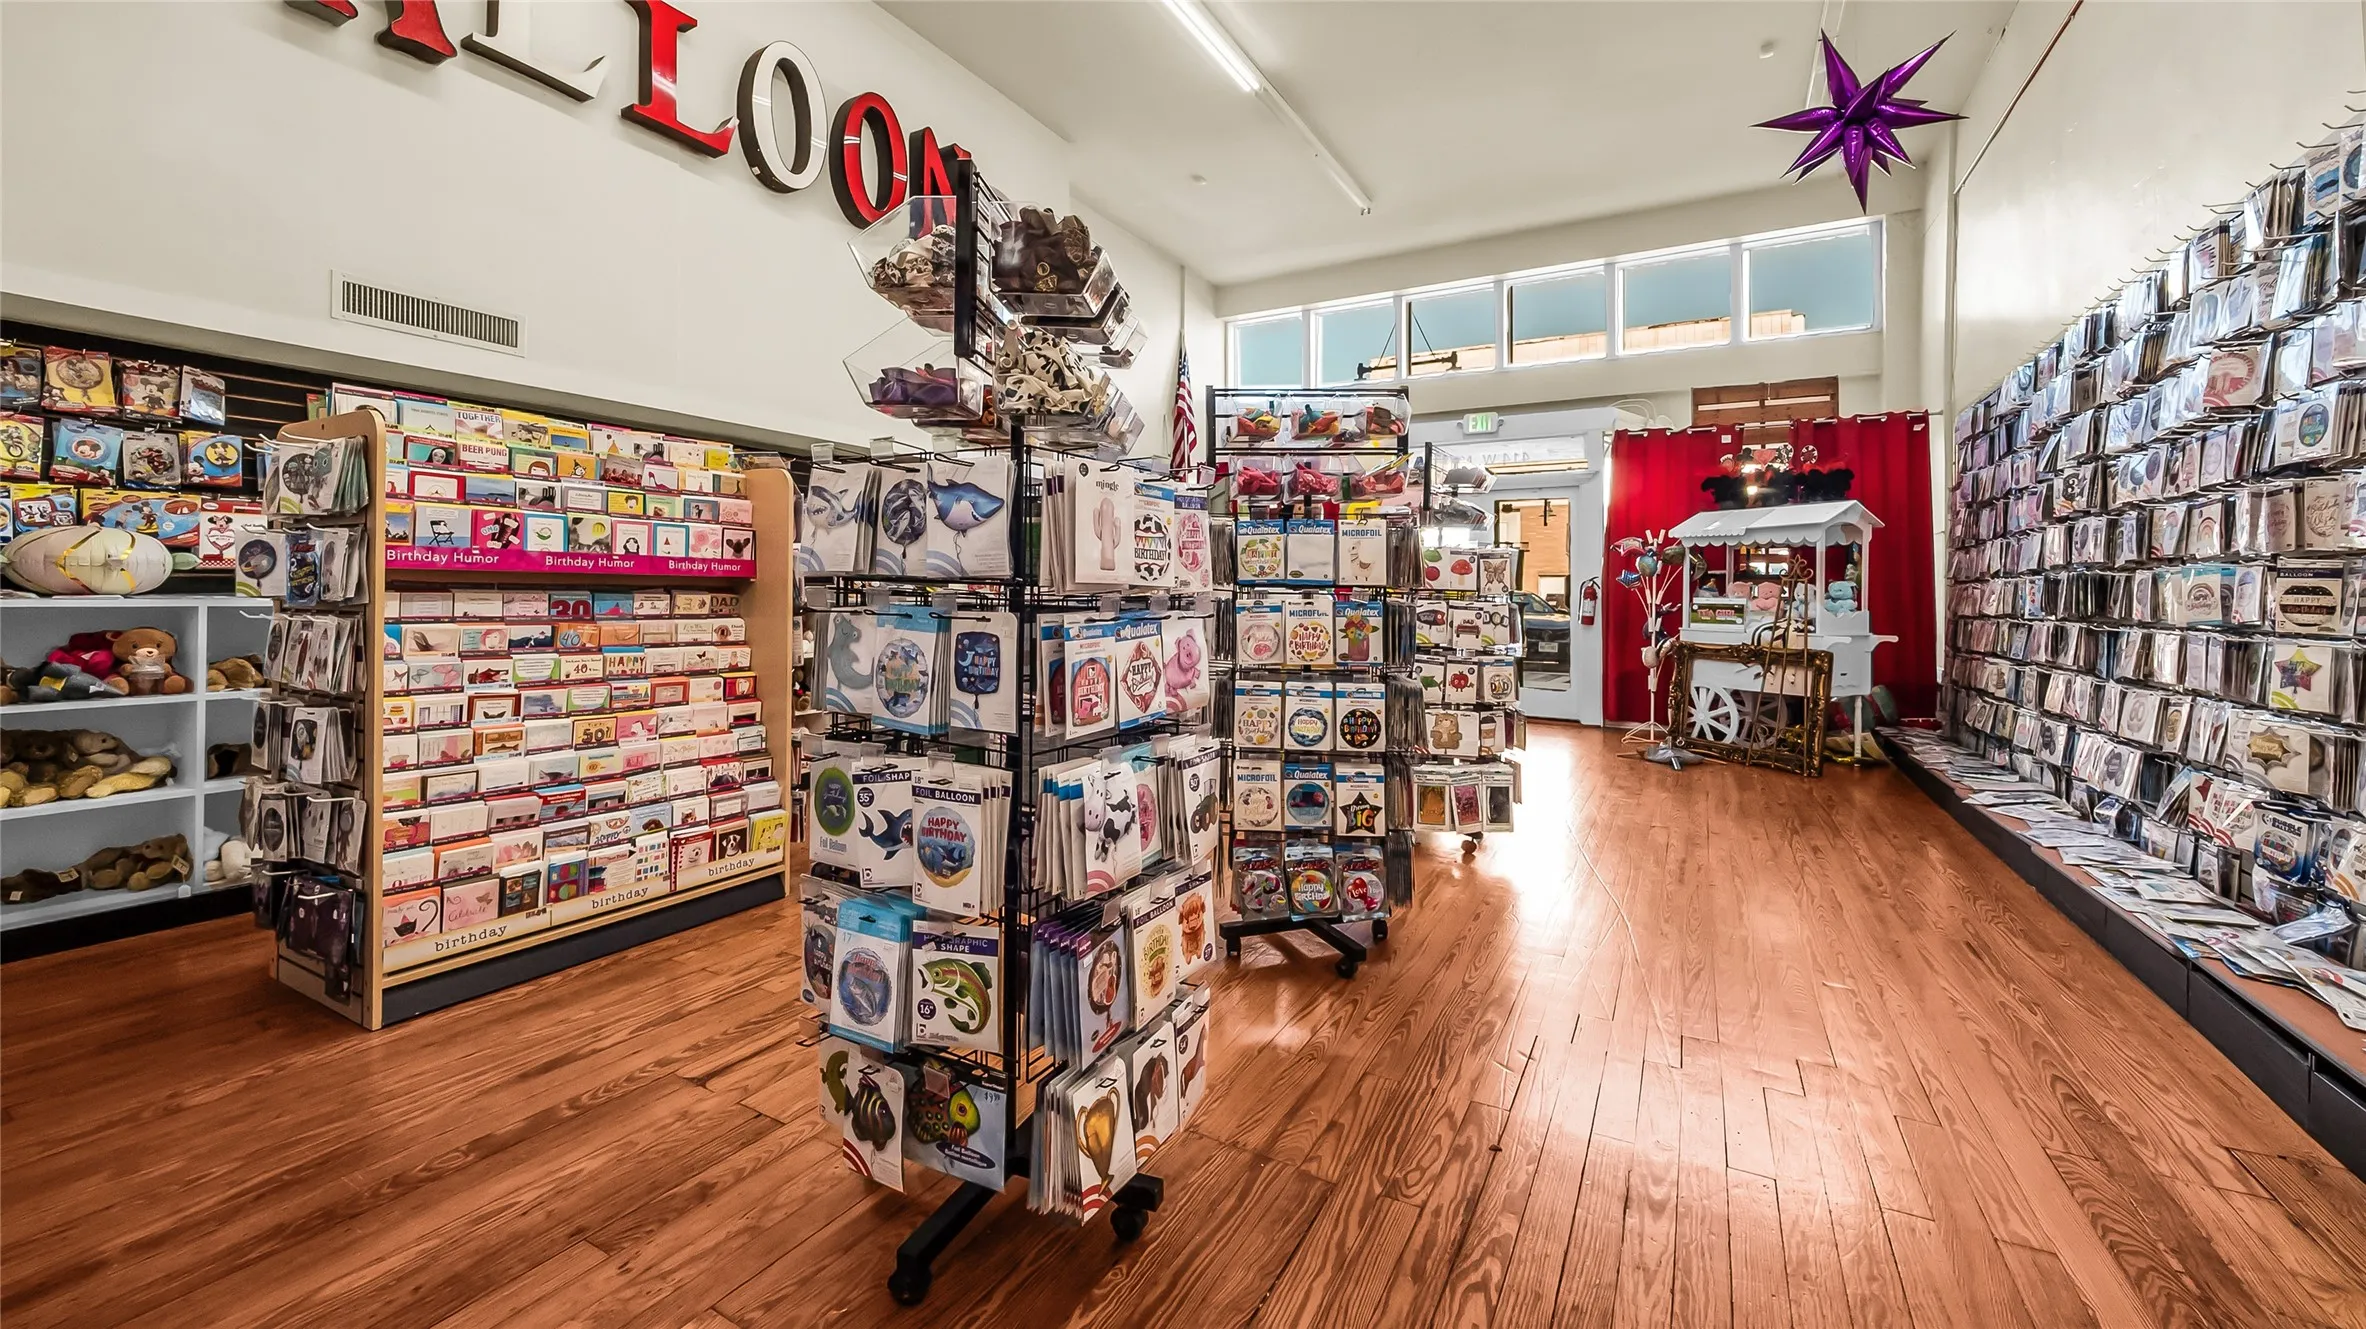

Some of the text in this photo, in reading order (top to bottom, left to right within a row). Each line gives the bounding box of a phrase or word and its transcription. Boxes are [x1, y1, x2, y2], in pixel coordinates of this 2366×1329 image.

[457, 411, 501, 423] TOGETHER
[1469, 416, 1492, 432] EXIT
[462, 444, 508, 458] BEER PONG
[1095, 479, 1120, 492] mingle
[1247, 526, 1280, 535] Qualatex
[1298, 525, 1332, 536] Qualatex
[1342, 529, 1382, 537] MICROFOIL
[386, 549, 500, 566] Birthday Humor
[1134, 548, 1166, 560] BIRTHDAY
[545, 556, 635, 570] Birthday Humor
[668, 560, 741, 572] Birthday Humor
[710, 596, 740, 608] DAD
[1344, 607, 1380, 618] Qualatex
[1126, 622, 1158, 640] Qualatex
[1299, 632, 1321, 642] HAPPY
[1294, 640, 1326, 651] BIRTHDAY
[609, 656, 646, 668] HAPPY
[974, 656, 997, 666] HAPPY
[968, 666, 1000, 677] BIRTHDAY
[1490, 682, 1509, 692] DAD
[1242, 720, 1274, 731] HAPPY
[862, 774, 883, 782] FOIL
[1237, 774, 1278, 782] MICROFOIL
[1294, 770, 1328, 780] Qualatex
[915, 788, 976, 803] FOIL BALLOON
[1350, 804, 1370, 812] Dream
[1348, 808, 1374, 827] BIG
[928, 818, 960, 830] HAPPY
[2272, 822, 2302, 838] BALLOON
[2273, 816, 2303, 832] BUBBLE
[922, 828, 968, 844] BIRTHDAY
[708, 858, 755, 877] birthday
[1298, 882, 1324, 892] Happy
[592, 887, 649, 910] birthday
[1150, 901, 1174, 918] BALLOON
[435, 925, 508, 952] birthday
[940, 943, 970, 953] SHAPE
